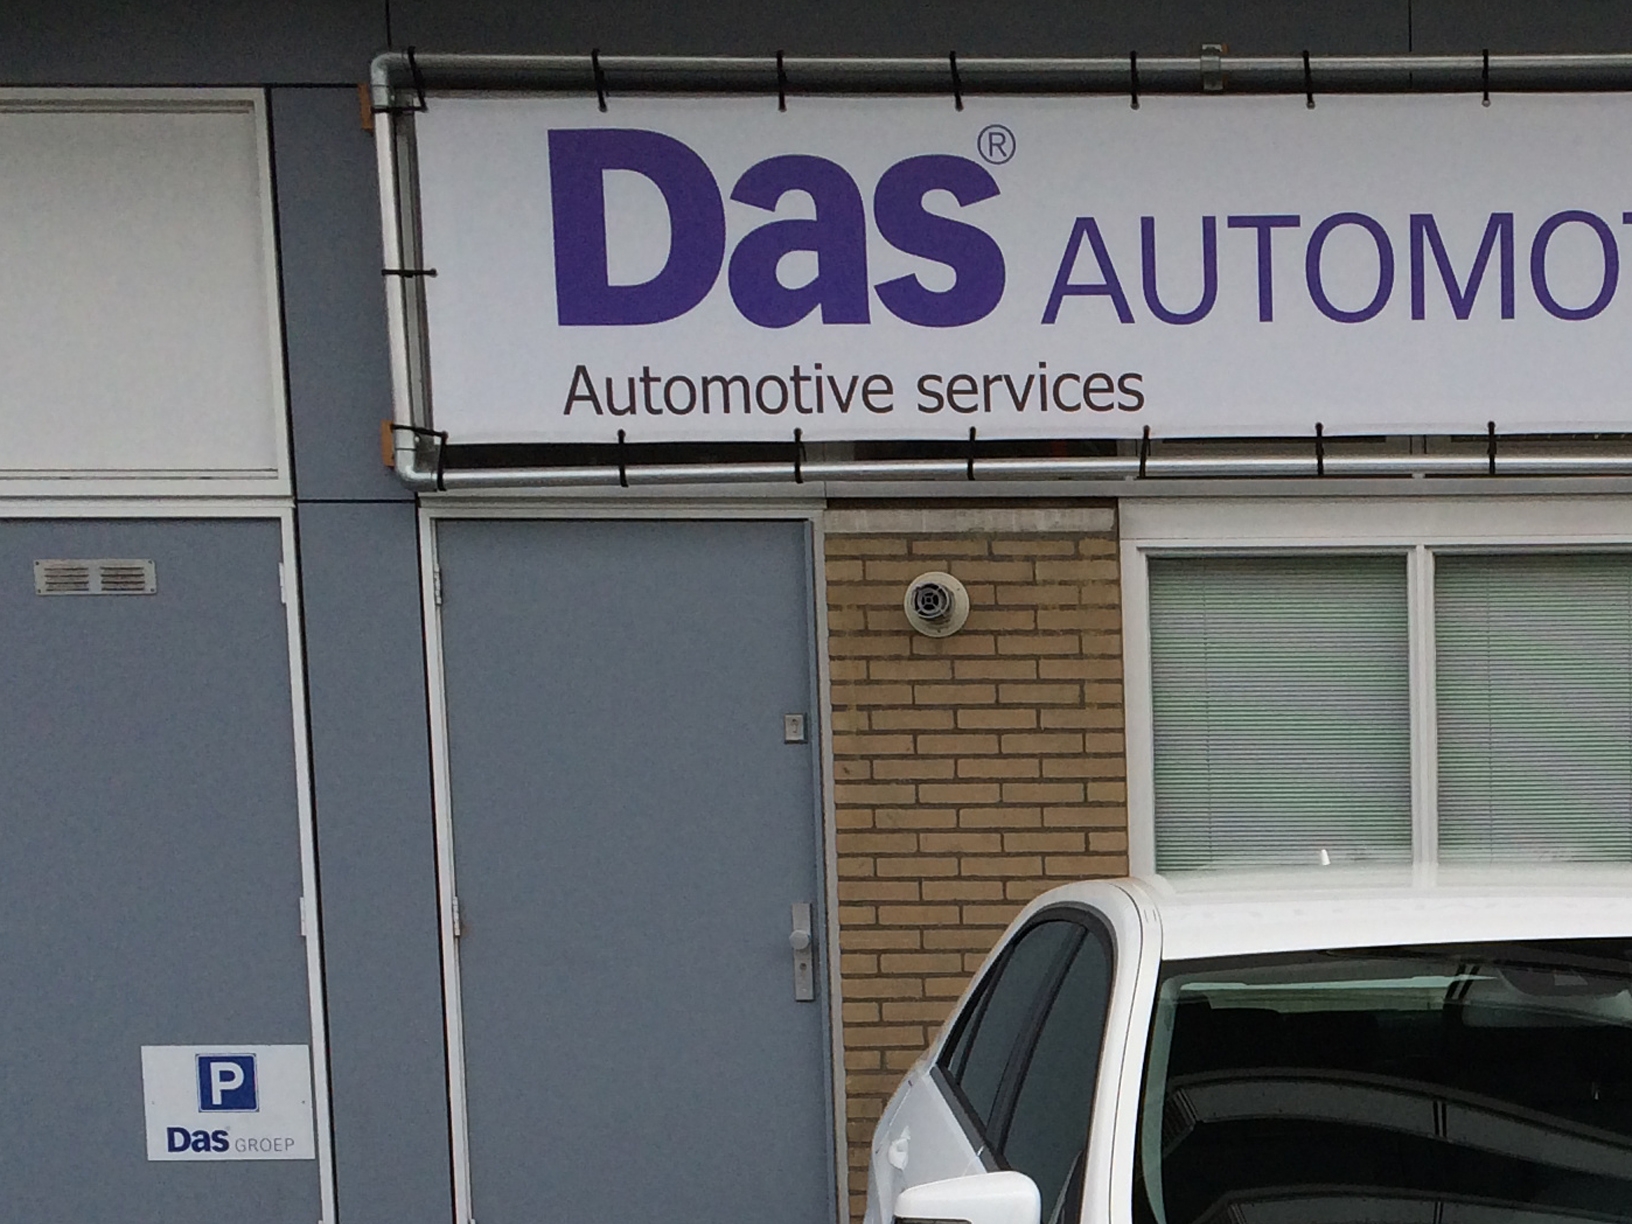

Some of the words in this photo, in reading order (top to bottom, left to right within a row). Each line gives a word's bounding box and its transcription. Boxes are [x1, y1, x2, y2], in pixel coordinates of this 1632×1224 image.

[562, 361, 896, 416] Automotive
[916, 361, 1146, 413] services
[209, 1061, 245, 1105] P
[166, 1126, 230, 1153] Das
[234, 1137, 295, 1153] GROEP
